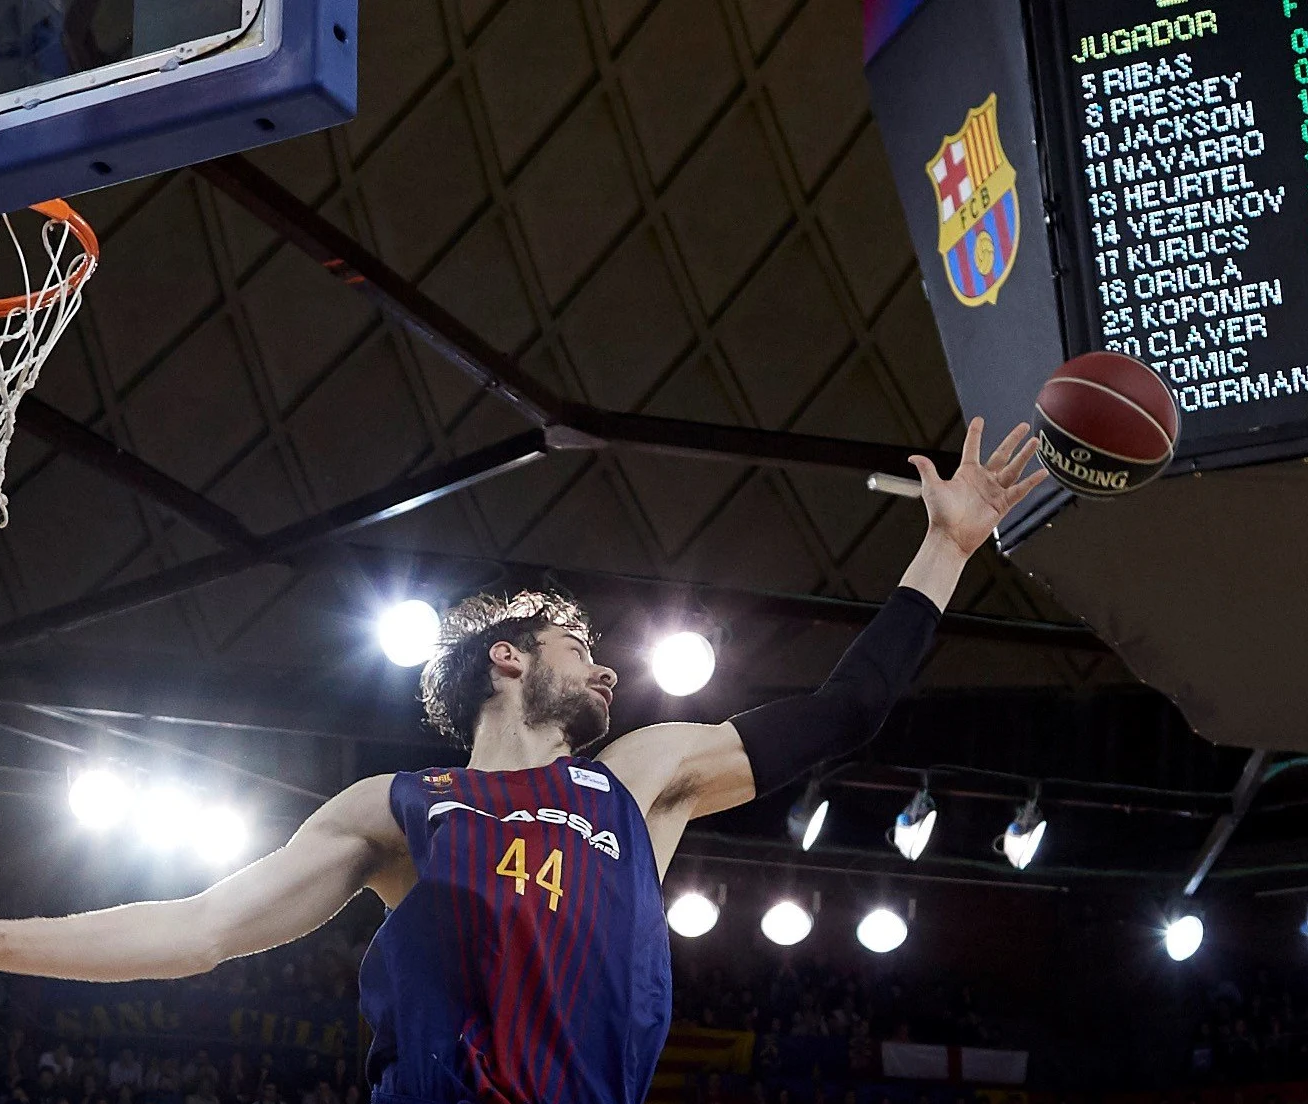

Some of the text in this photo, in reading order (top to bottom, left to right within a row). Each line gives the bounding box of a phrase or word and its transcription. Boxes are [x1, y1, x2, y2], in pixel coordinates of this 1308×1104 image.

[1072, 9, 1218, 63] JUGADOR
[1081, 72, 1097, 100] 5
[1102, 52, 1193, 96] RIBAS
[1109, 72, 1242, 124] PRESSEY
[1081, 131, 1110, 159] 10
[1118, 100, 1255, 152] JACKSON
[1085, 162, 1107, 188] 11
[1113, 130, 1265, 184] NAVARRO
[959, 186, 990, 230] FCB
[1088, 190, 1118, 217] 13
[1123, 164, 1254, 212] HEURTEL
[1092, 220, 1121, 248] 14
[1126, 186, 1285, 239] VEZENKOV
[1094, 249, 1119, 277] 17
[1126, 225, 1250, 271] KURUCS
[1098, 279, 1127, 306] 18
[1133, 257, 1243, 299] ORIOLA
[1101, 307, 1134, 336] 25
[1141, 279, 1283, 330] KOPONEN
[1147, 313, 1267, 357] CLAVER
[496, 838, 563, 912] 44
